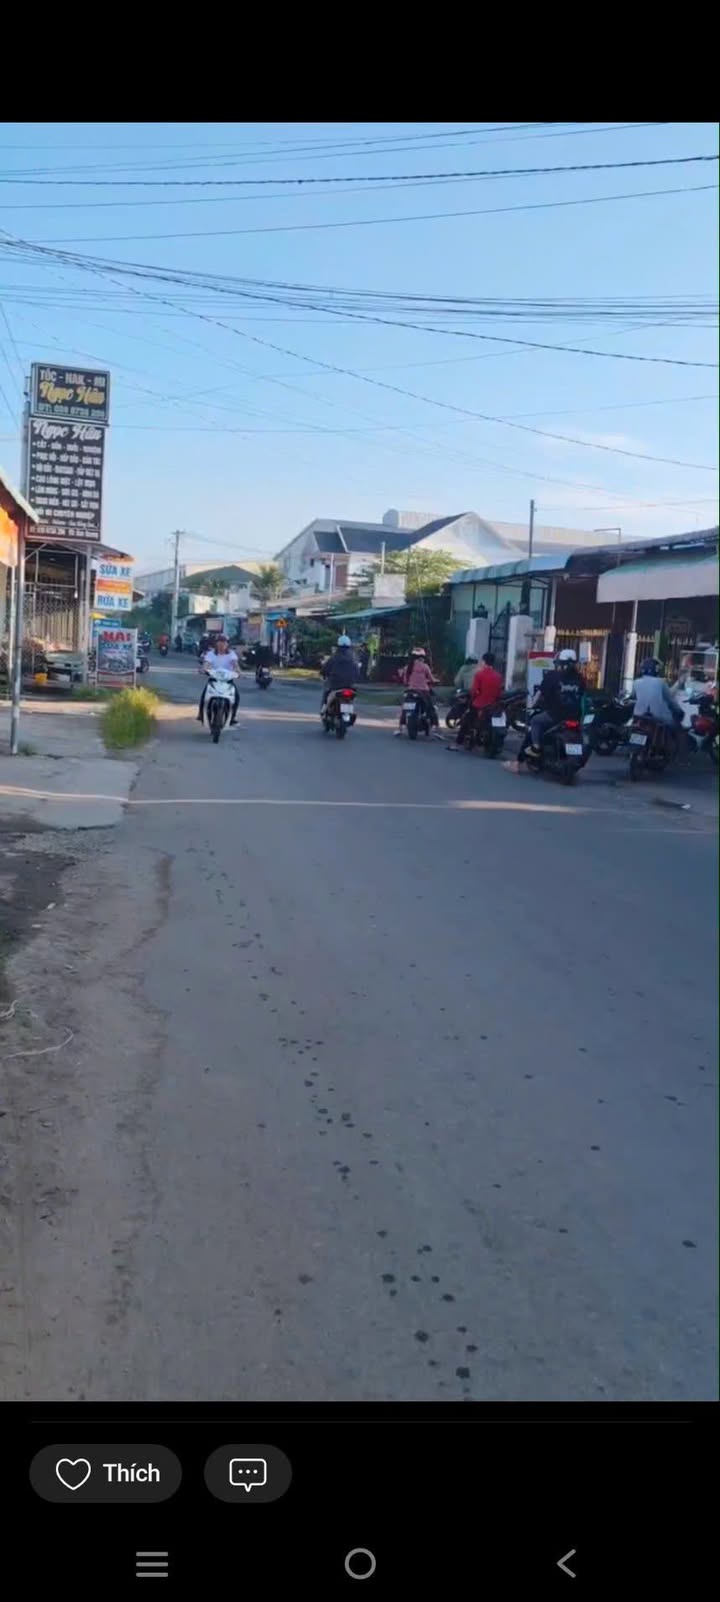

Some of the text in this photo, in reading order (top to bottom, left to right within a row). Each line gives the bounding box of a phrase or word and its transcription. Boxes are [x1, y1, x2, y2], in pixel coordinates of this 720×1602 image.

[99, 561, 131, 577] SỬA XE
[118, 598, 129, 608] XE
